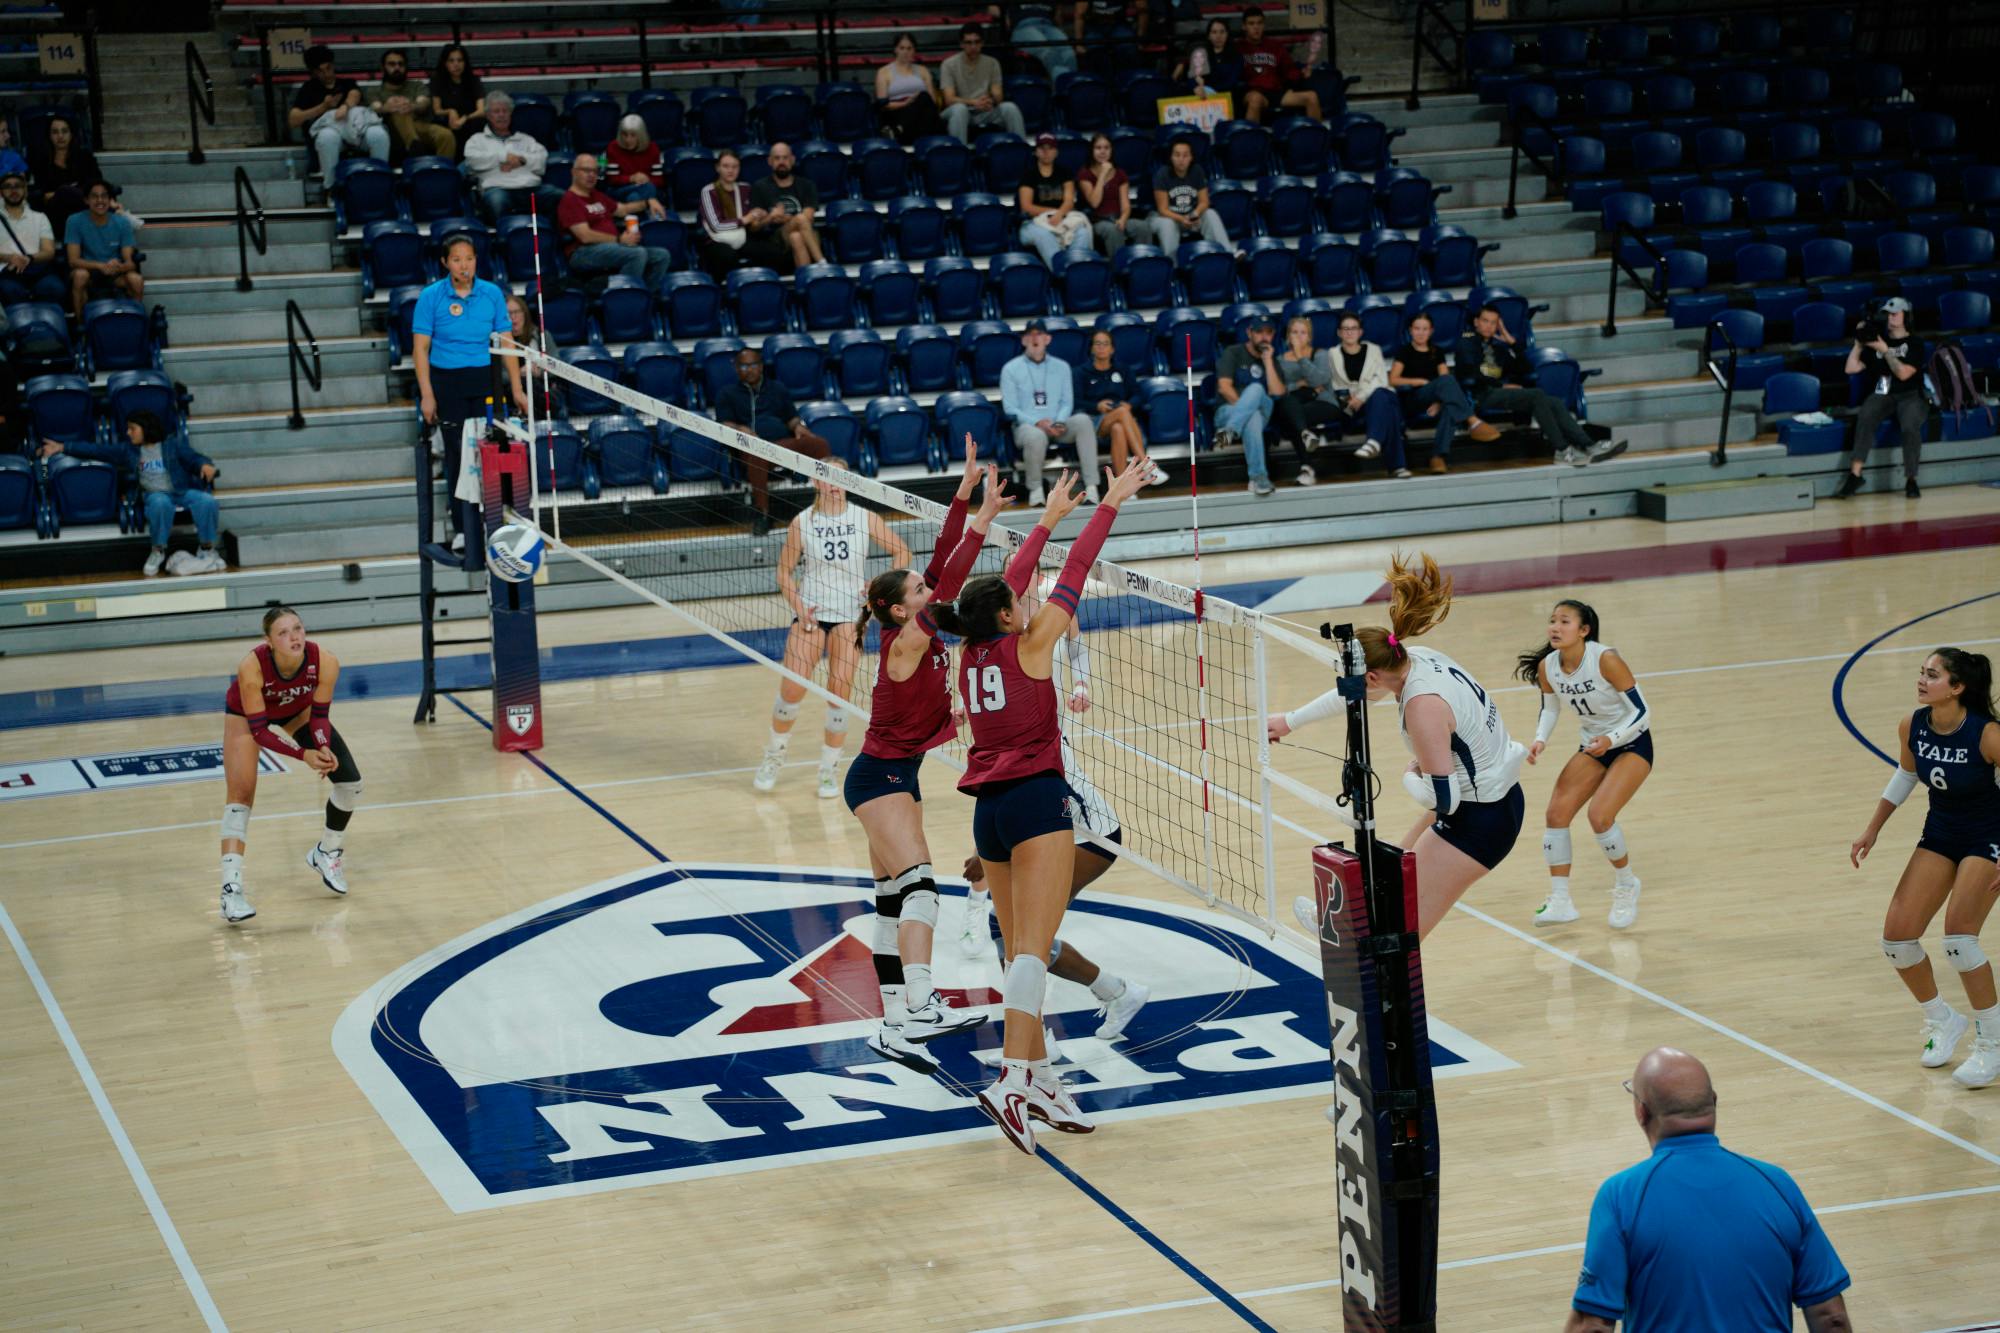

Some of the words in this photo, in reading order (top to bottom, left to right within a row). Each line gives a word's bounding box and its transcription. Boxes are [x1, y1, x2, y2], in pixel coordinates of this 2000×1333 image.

[48, 45, 74, 60] 114
[279, 39, 305, 55] 115
[815, 461, 830, 477] PENN
[904, 493, 922, 513] PENN
[815, 524, 856, 538] YALE
[824, 540, 849, 561] 33
[1126, 571, 1149, 593] PENN
[264, 684, 313, 698] PENN
[966, 665, 1007, 714] 19
[1557, 680, 1596, 695] YALE
[1570, 698, 1597, 716] 11
[517, 716, 527, 729] P
[1916, 741, 1969, 764] YALE
[1929, 766, 1948, 791] 6
[536, 1010, 1331, 1166] PENN
[1328, 990, 1376, 1313] PENN
